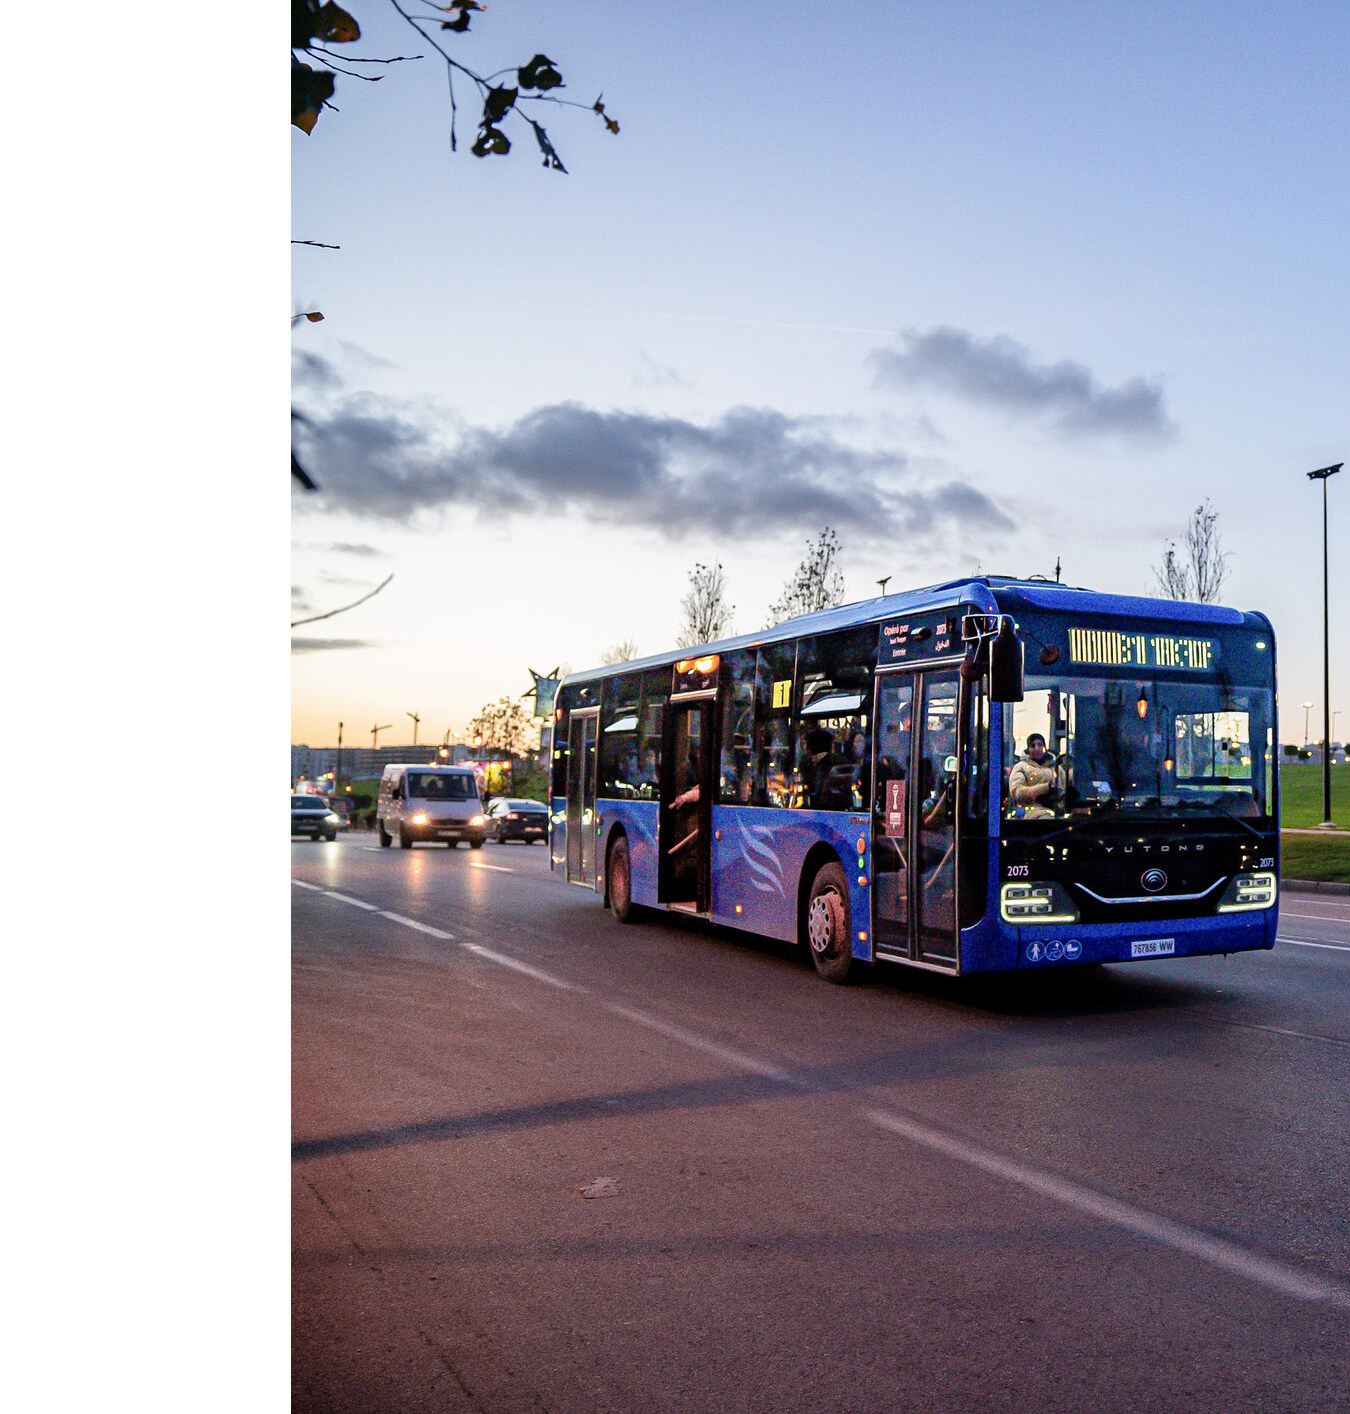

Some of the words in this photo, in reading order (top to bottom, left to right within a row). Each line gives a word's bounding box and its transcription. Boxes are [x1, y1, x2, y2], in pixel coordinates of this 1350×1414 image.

[1105, 844, 1204, 853] YUTONG
[1259, 857, 1274, 868] 2073
[1007, 865, 1029, 877] 2073
[1159, 940, 1174, 951] WW
